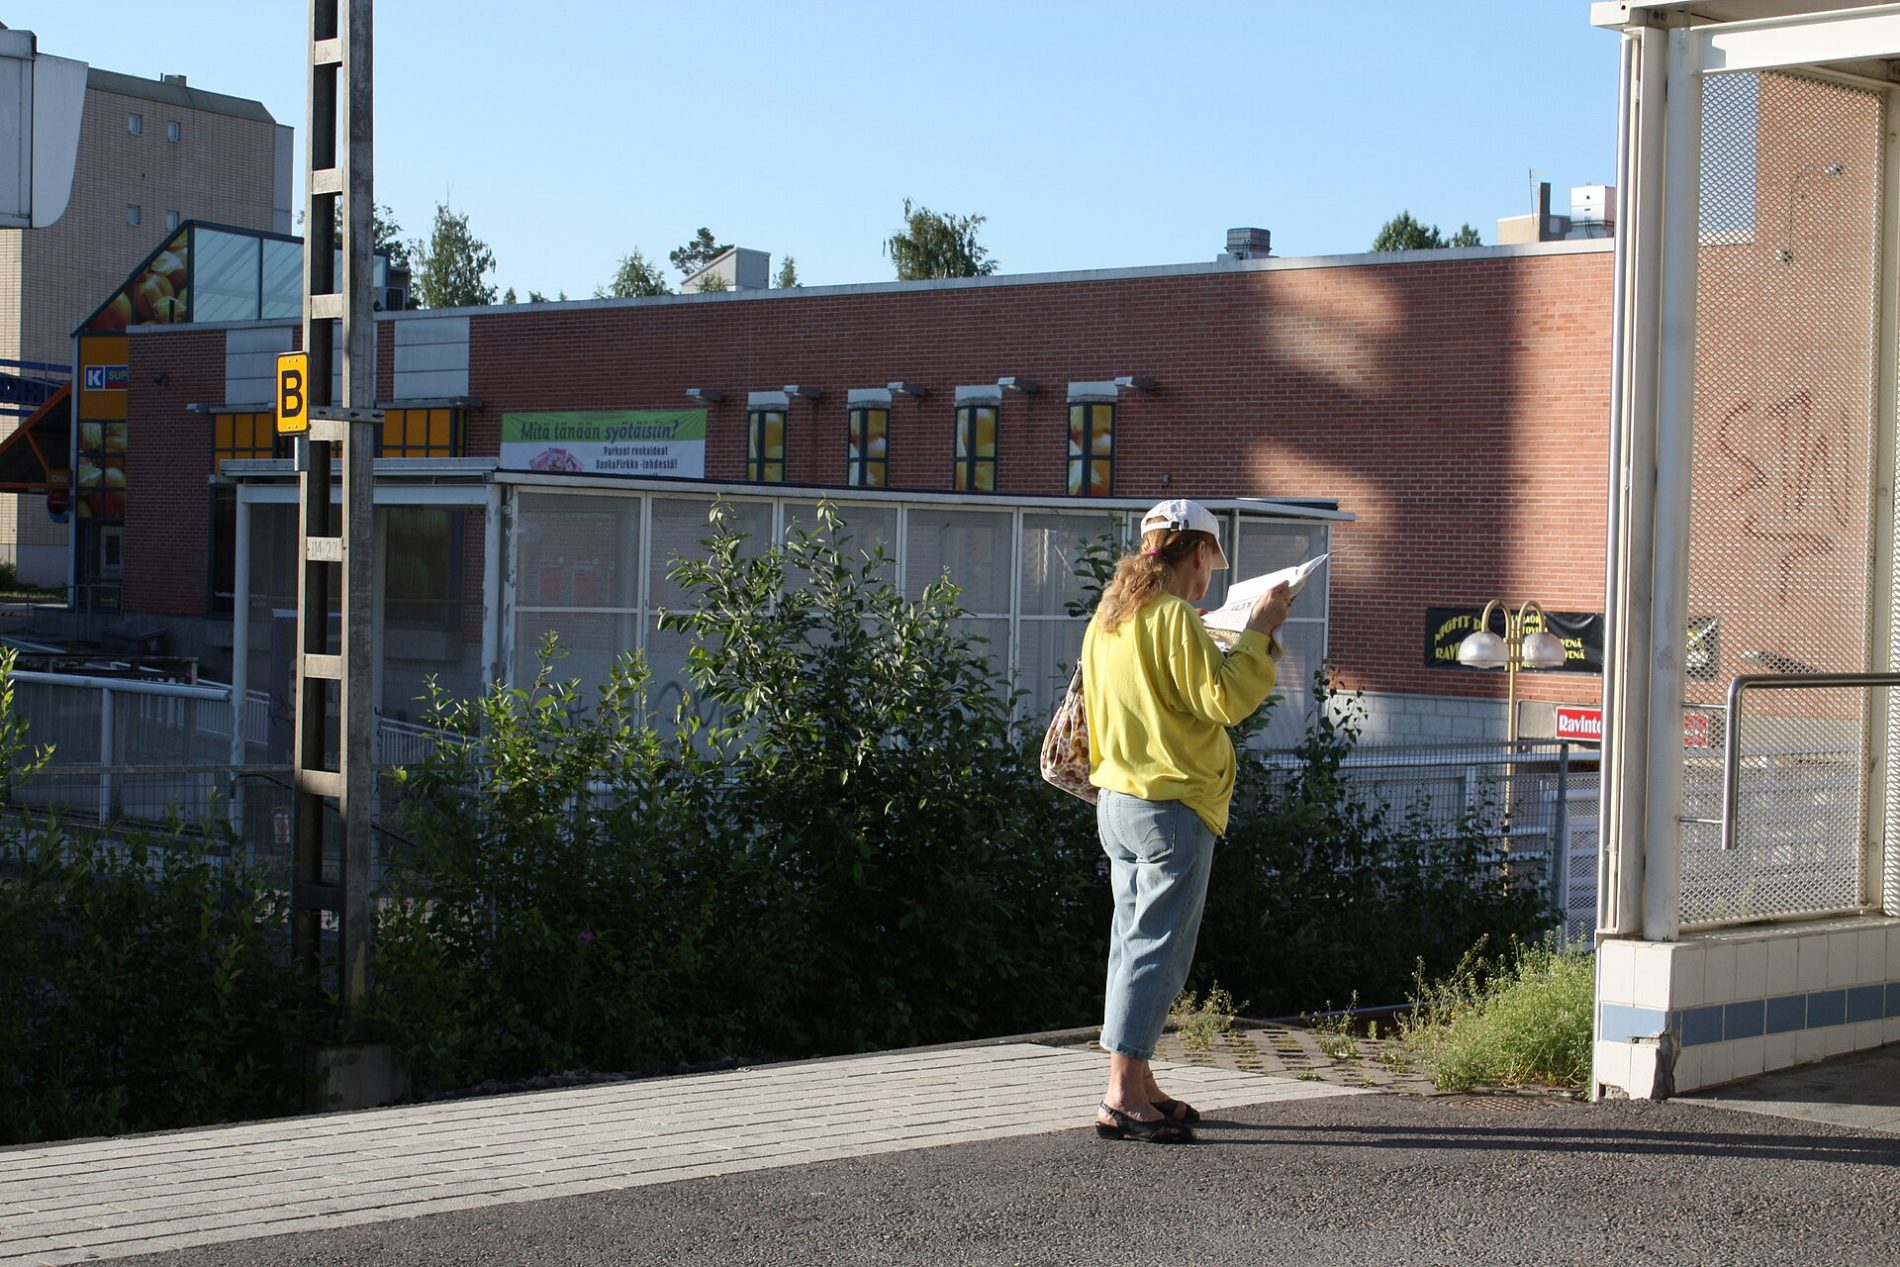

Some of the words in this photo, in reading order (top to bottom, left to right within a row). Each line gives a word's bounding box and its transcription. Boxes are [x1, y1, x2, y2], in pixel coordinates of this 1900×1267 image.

[88, 370, 101, 386] K
[281, 369, 303, 418] B
[521, 422, 550, 440] Mitä
[554, 421, 600, 440] tänään
[605, 420, 681, 443] syötäisiin?
